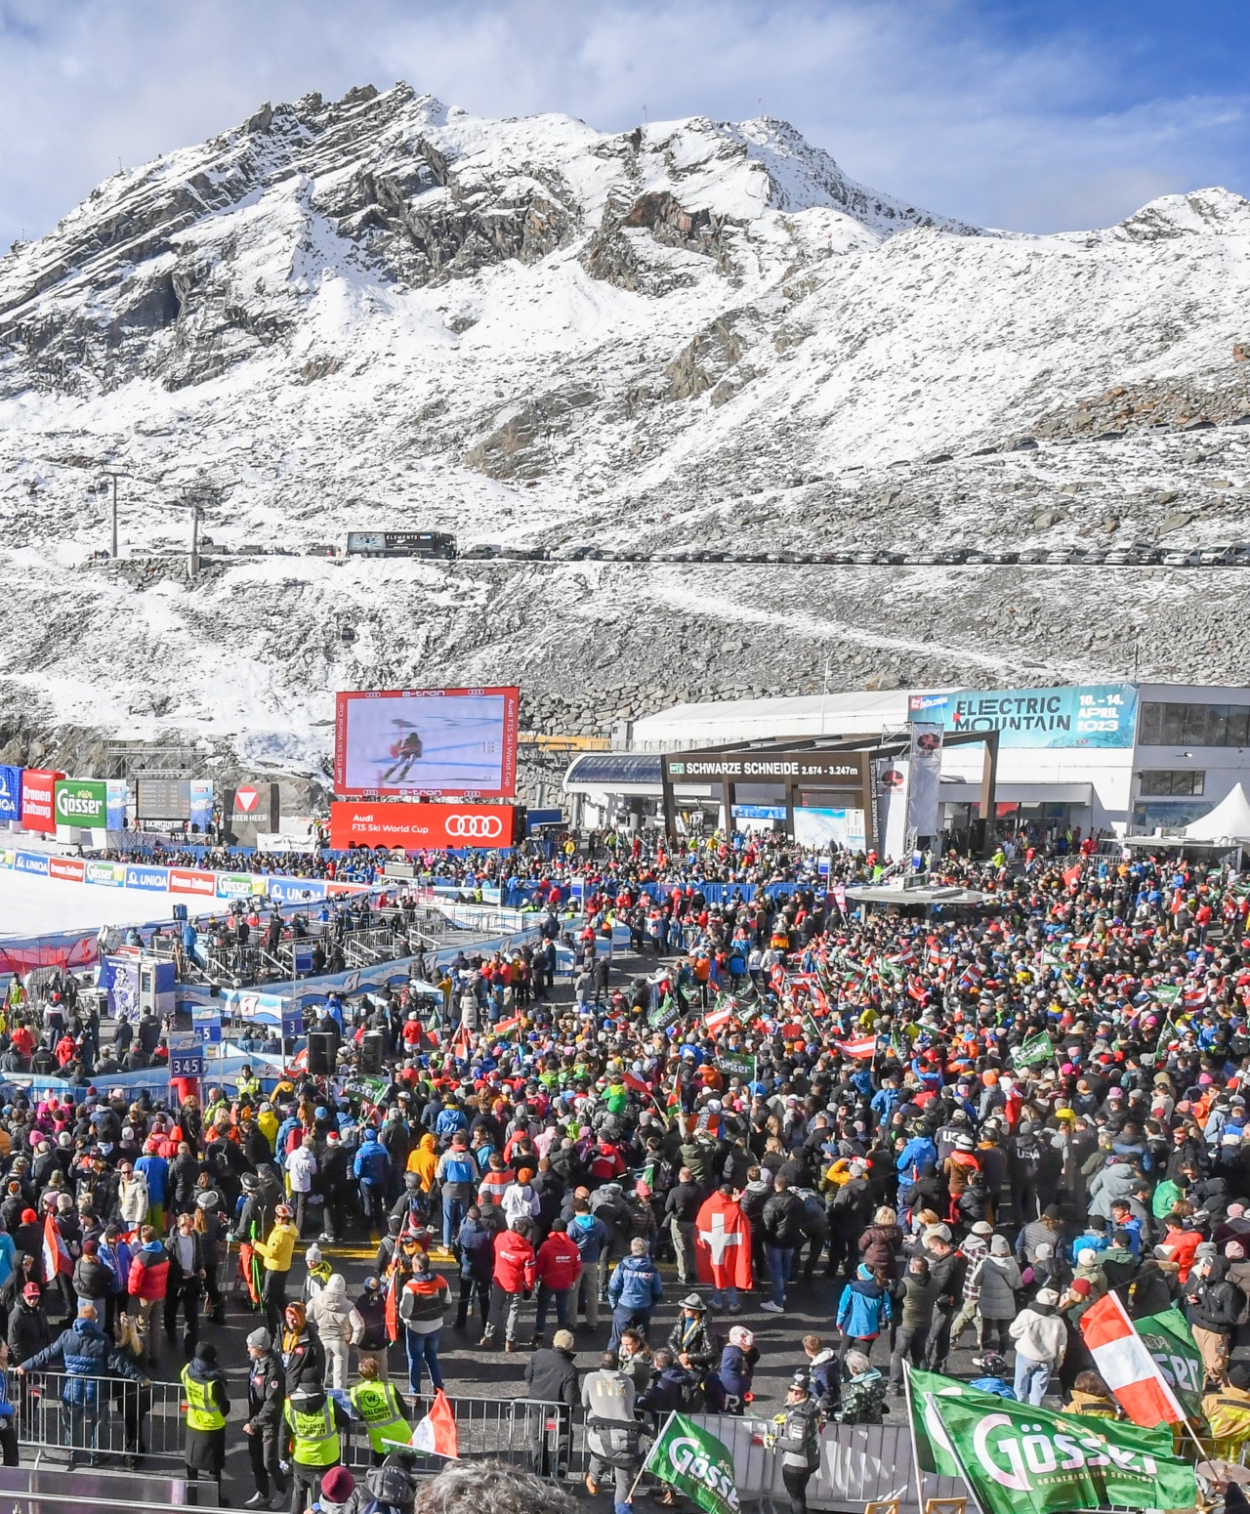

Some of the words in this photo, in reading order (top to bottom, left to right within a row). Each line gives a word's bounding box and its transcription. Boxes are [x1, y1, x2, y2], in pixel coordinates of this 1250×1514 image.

[956, 695, 1061, 716] ELECTRIC
[1106, 694, 1124, 705] 14.
[1078, 707, 1119, 718] APRIL
[955, 714, 1071, 732] MOUNTAIN
[1077, 720, 1119, 731] 2023
[686, 762, 742, 775] SCHWARZE
[744, 762, 799, 775] SCHNEIDE
[802, 766, 822, 775] 2.674
[829, 766, 858, 775] 3.247m
[23, 786, 51, 802] Kronen
[57, 788, 103, 817] Gösser
[22, 801, 51, 819] Zeitung
[249, 814, 267, 822] HEER
[352, 814, 373, 822] Audi
[368, 824, 381, 832] Ski
[382, 825, 409, 833] World
[411, 826, 429, 834] Cup
[26, 858, 48, 872] UNIQA
[140, 874, 167, 887] UNIQA
[290, 1020, 295, 1033] 3
